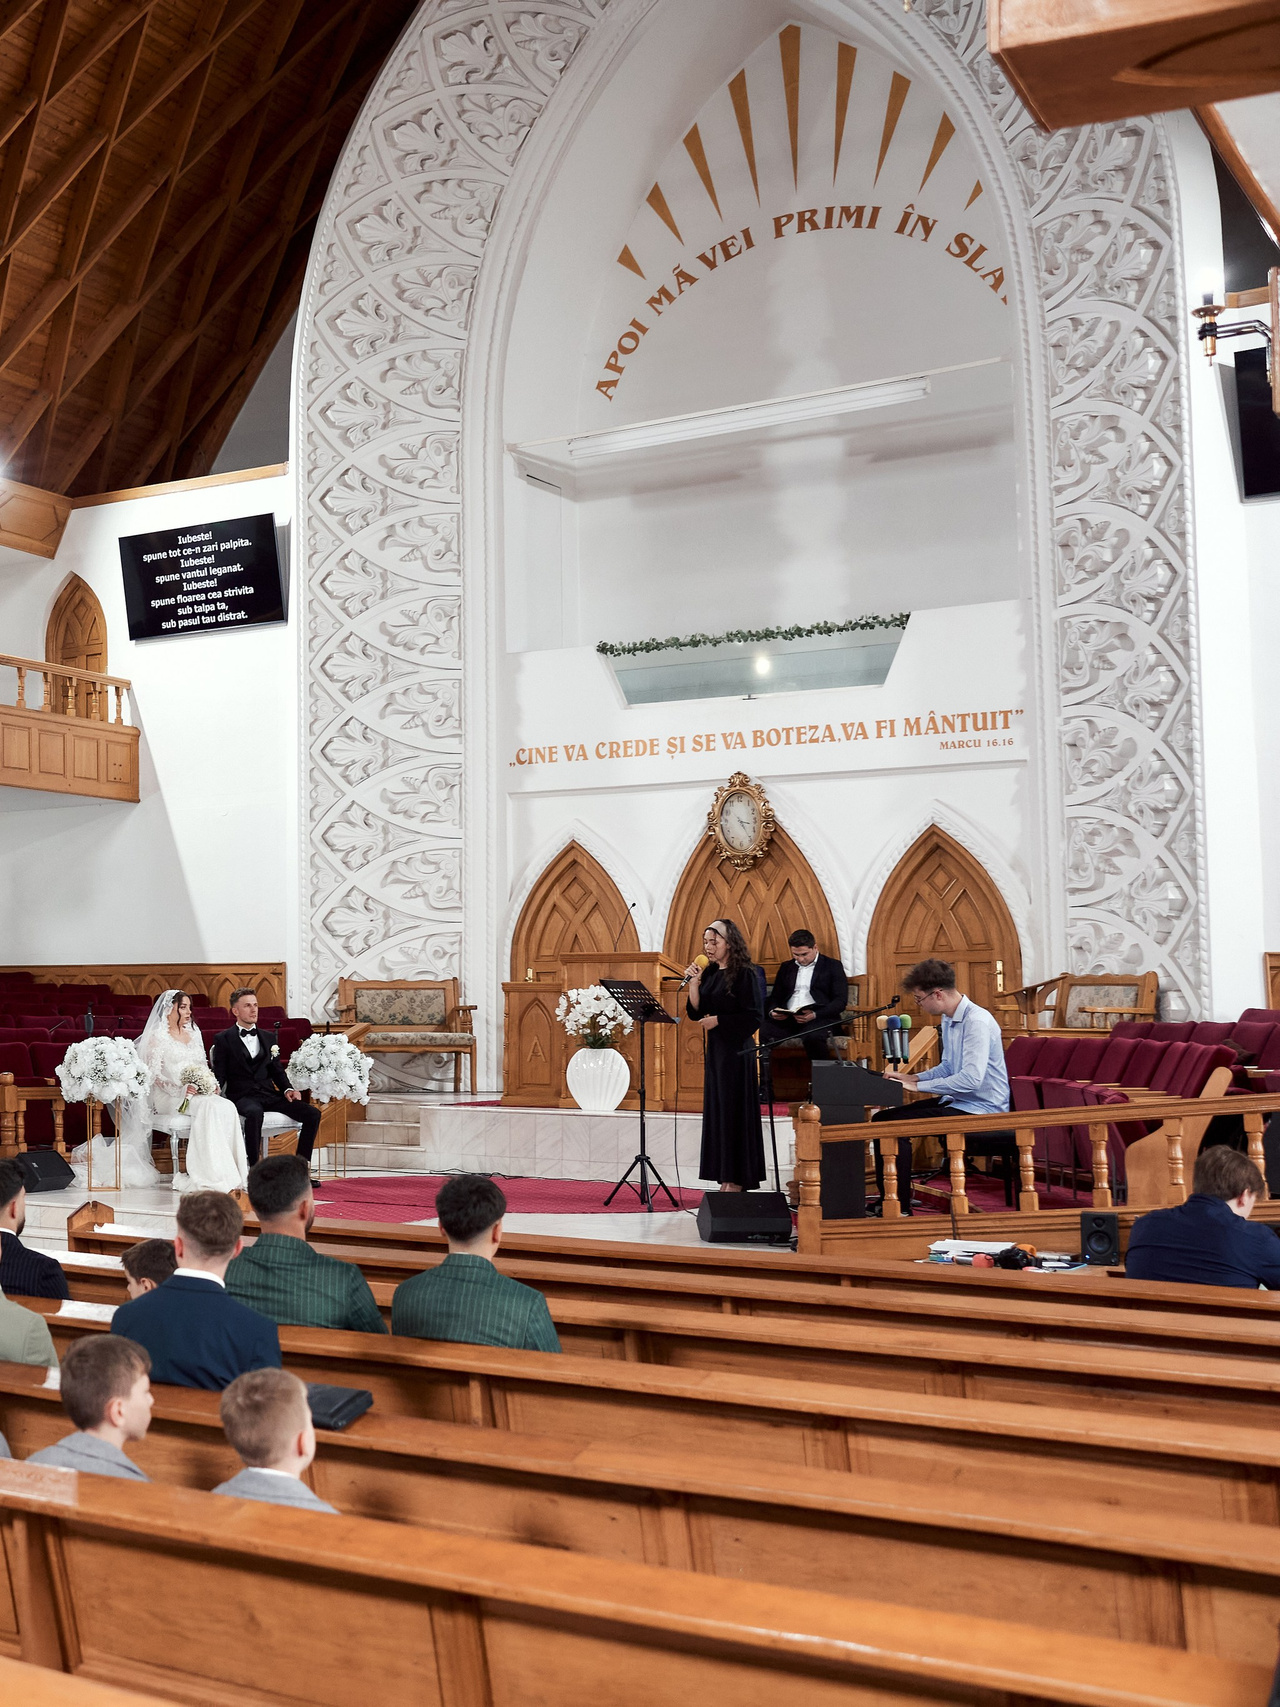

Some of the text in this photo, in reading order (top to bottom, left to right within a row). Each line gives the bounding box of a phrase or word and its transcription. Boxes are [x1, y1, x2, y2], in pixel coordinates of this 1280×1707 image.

[595, 317, 650, 402] APOI
[696, 226, 756, 271] VEI
[772, 205, 883, 240] PRIMI
[894, 203, 939, 243] ÎN
[945, 232, 1008, 306] SLA
[178, 531, 212, 544] Iubeste!
[143, 538, 252, 562] spune tot ce-n zari palpita.
[180, 555, 215, 568] Iubeste!
[155, 563, 244, 584] spune vantul leganat.
[182, 578, 217, 591] Iubeste!
[151, 586, 254, 608] spune floarea cea strivita
[178, 601, 229, 615] sub talpa ta,
[162, 610, 248, 629] sub pasul tau distrat.
[563, 743, 588, 761] VA
[595, 738, 660, 760] CREDE
[666, 736, 686, 760] ȘI
[691, 733, 716, 753] SE
[721, 731, 747, 750] VA
[875, 719, 896, 739] FI
[939, 738, 1014, 750] MARCU 16.16
